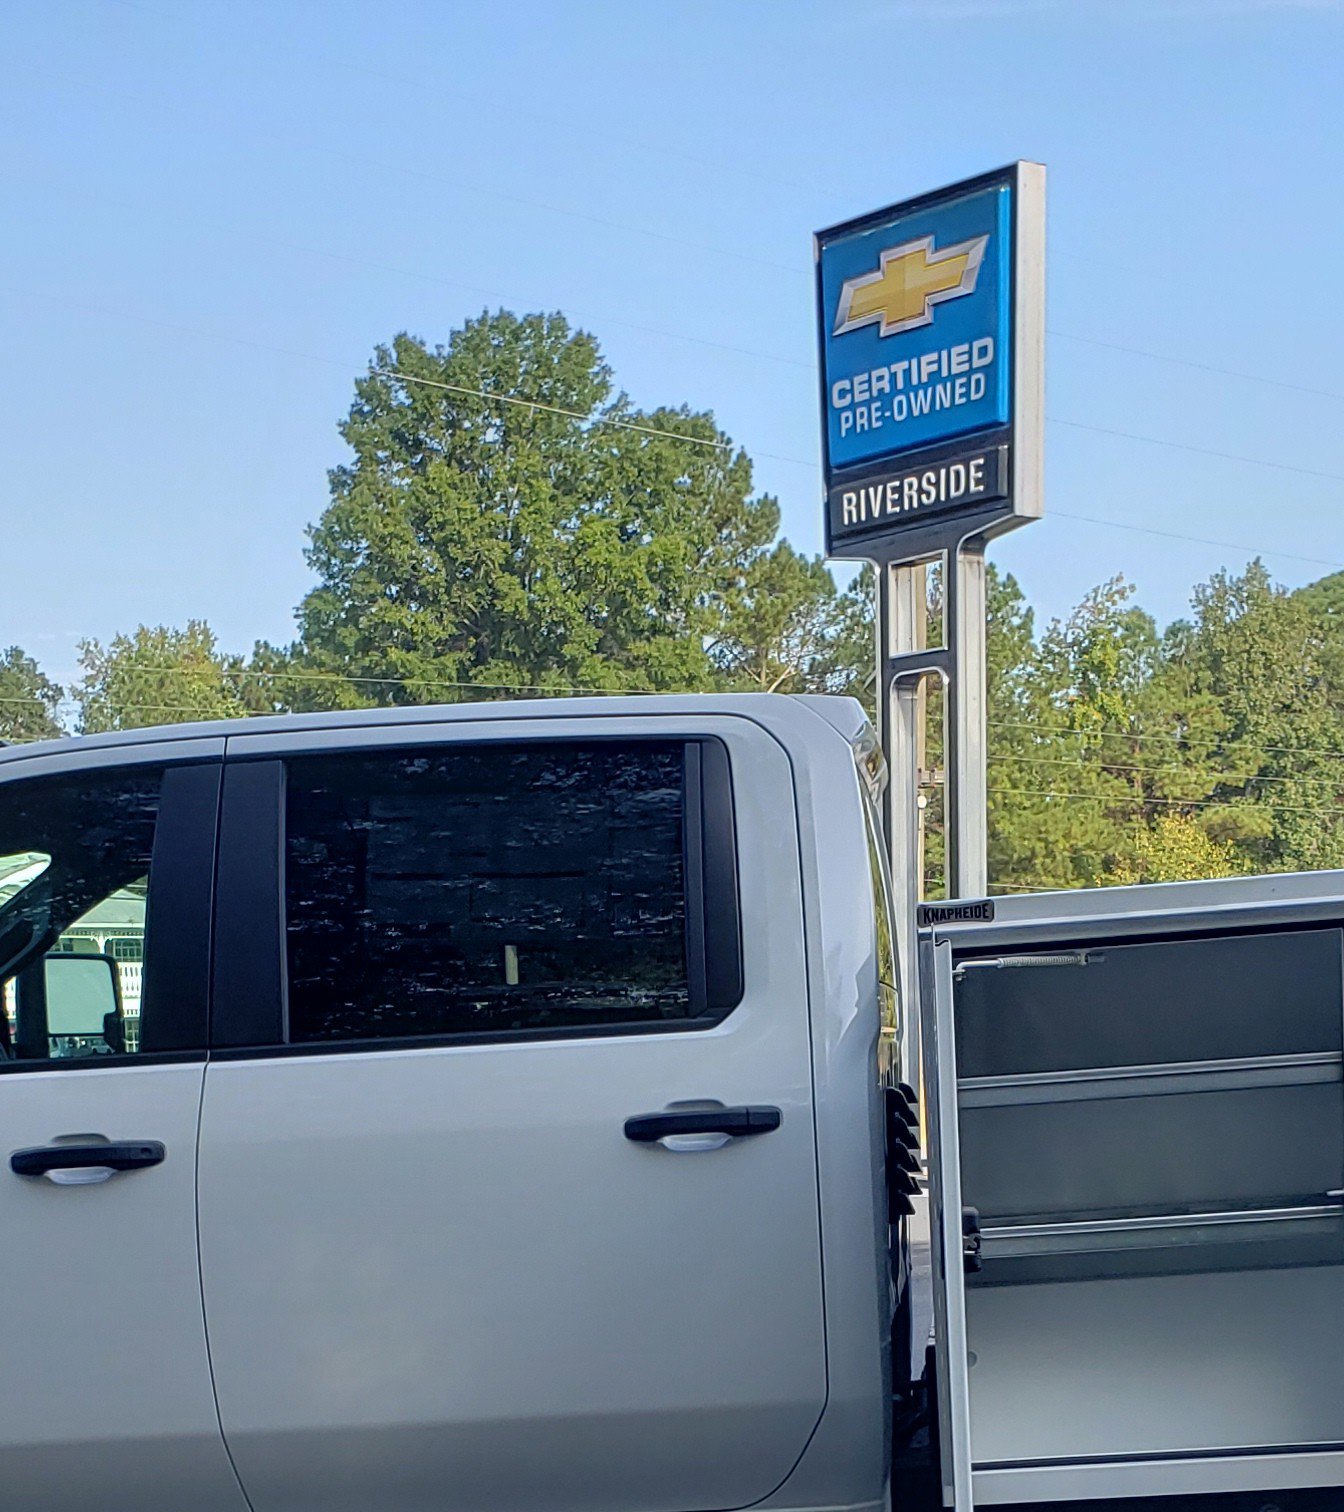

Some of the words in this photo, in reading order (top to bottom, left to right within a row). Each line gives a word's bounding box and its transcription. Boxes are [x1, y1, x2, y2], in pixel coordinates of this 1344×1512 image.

[832, 336, 994, 410] CERTIFIED
[840, 372, 986, 438] PRE-OWNED
[842, 457, 985, 526] RIVERSIDE
[923, 902, 990, 925] KNAPHEIDE
